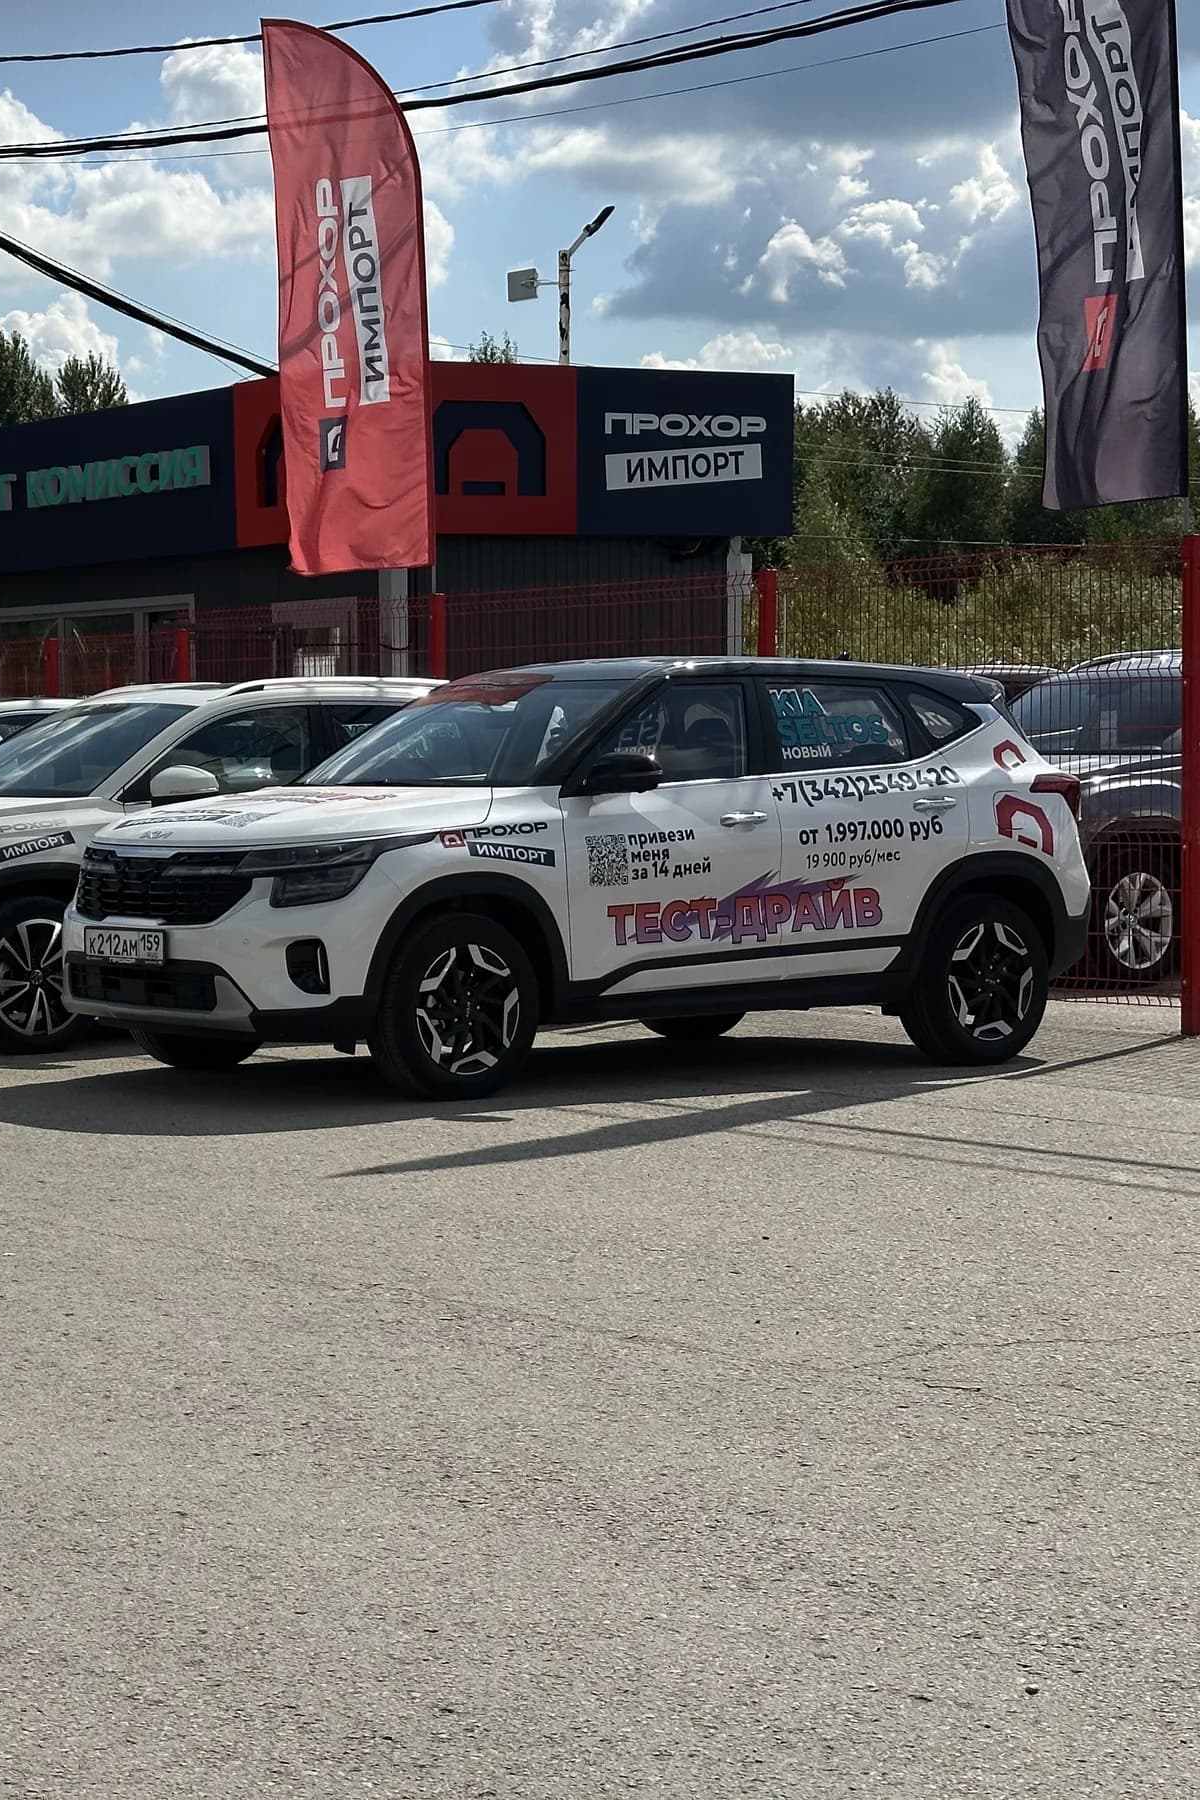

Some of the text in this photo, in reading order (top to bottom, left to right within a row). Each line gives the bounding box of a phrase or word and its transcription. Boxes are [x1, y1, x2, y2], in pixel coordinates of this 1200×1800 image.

[1058, 0, 1117, 282] ПРОХОР
[1091, 15, 1141, 251] МПОРТ
[315, 177, 347, 408] ПРОХОР
[348, 202, 385, 383] ИМПОРТ
[604, 412, 767, 438] ПРОХОР
[26, 445, 210, 509] КОМИССИЯ
[626, 450, 745, 484] ИМПОРТ
[769, 688, 827, 718] KIA
[776, 714, 889, 746] SELTOS
[782, 743, 832, 760] НОВЫЙ
[772, 765, 961, 808] +7(342)2549420
[463, 821, 549, 839] ПРОХОР
[628, 828, 696, 849] привези
[799, 814, 944, 846] от 1.997.000 руб
[2, 832, 67, 860] ИМПОРТ
[475, 843, 548, 865] ИМПОРТ
[630, 848, 670, 863] меня
[806, 847, 901, 869] 19 900 руб/мес
[631, 859, 712, 881] за 14 дней
[607, 878, 883, 946] ТЕСТ-ДРАЙВ
[140, 933, 160, 952] 159
